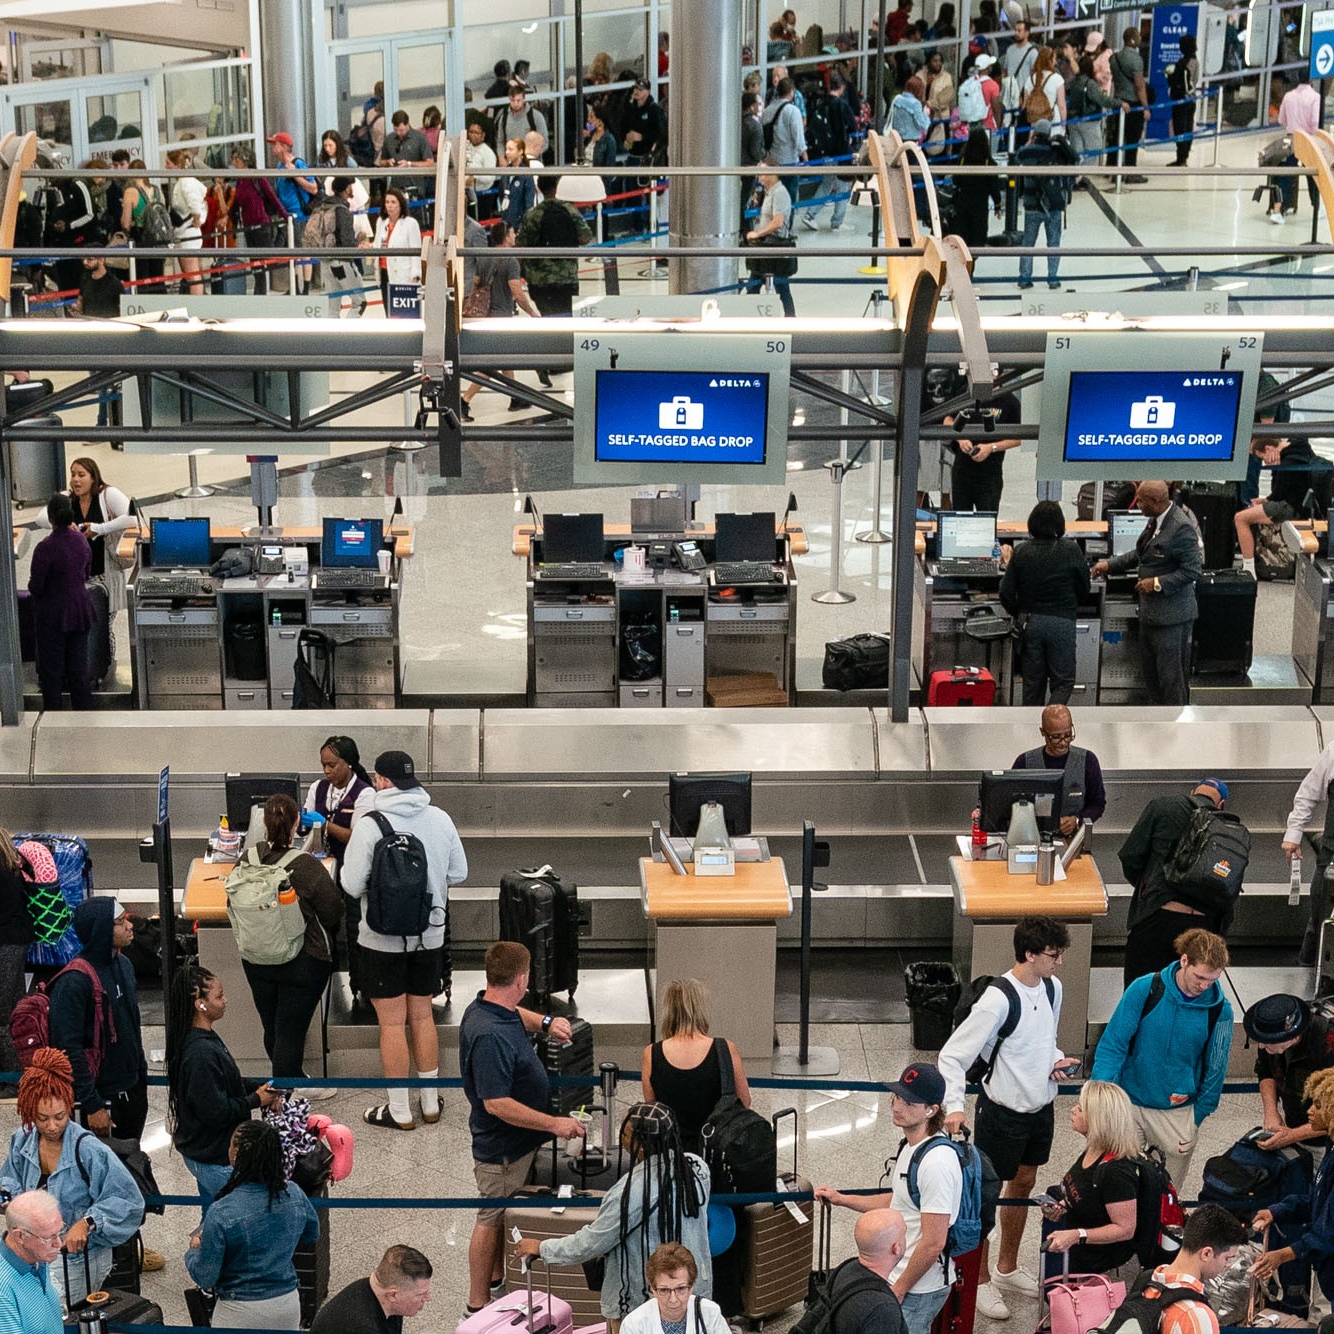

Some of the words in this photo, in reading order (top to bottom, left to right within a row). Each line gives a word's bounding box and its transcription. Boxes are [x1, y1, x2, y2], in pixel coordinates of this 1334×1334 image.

[1163, 26, 1188, 34] CLEAR
[393, 297, 417, 308] EXIT
[580, 339, 599, 351] 49
[766, 341, 786, 353] 50
[1055, 337, 1071, 349] 51
[1239, 336, 1256, 349] 52
[720, 379, 751, 388] DELTA
[1193, 378, 1225, 386] DELTA
[608, 434, 688, 446] SELF-TAGGED
[691, 435, 716, 447] BAG
[719, 436, 753, 447] DROP
[1078, 434, 1157, 446] SELF-TAGGED
[1160, 434, 1185, 446] BAG
[1188, 434, 1222, 446] DROP
[904, 1069, 919, 1084] C
